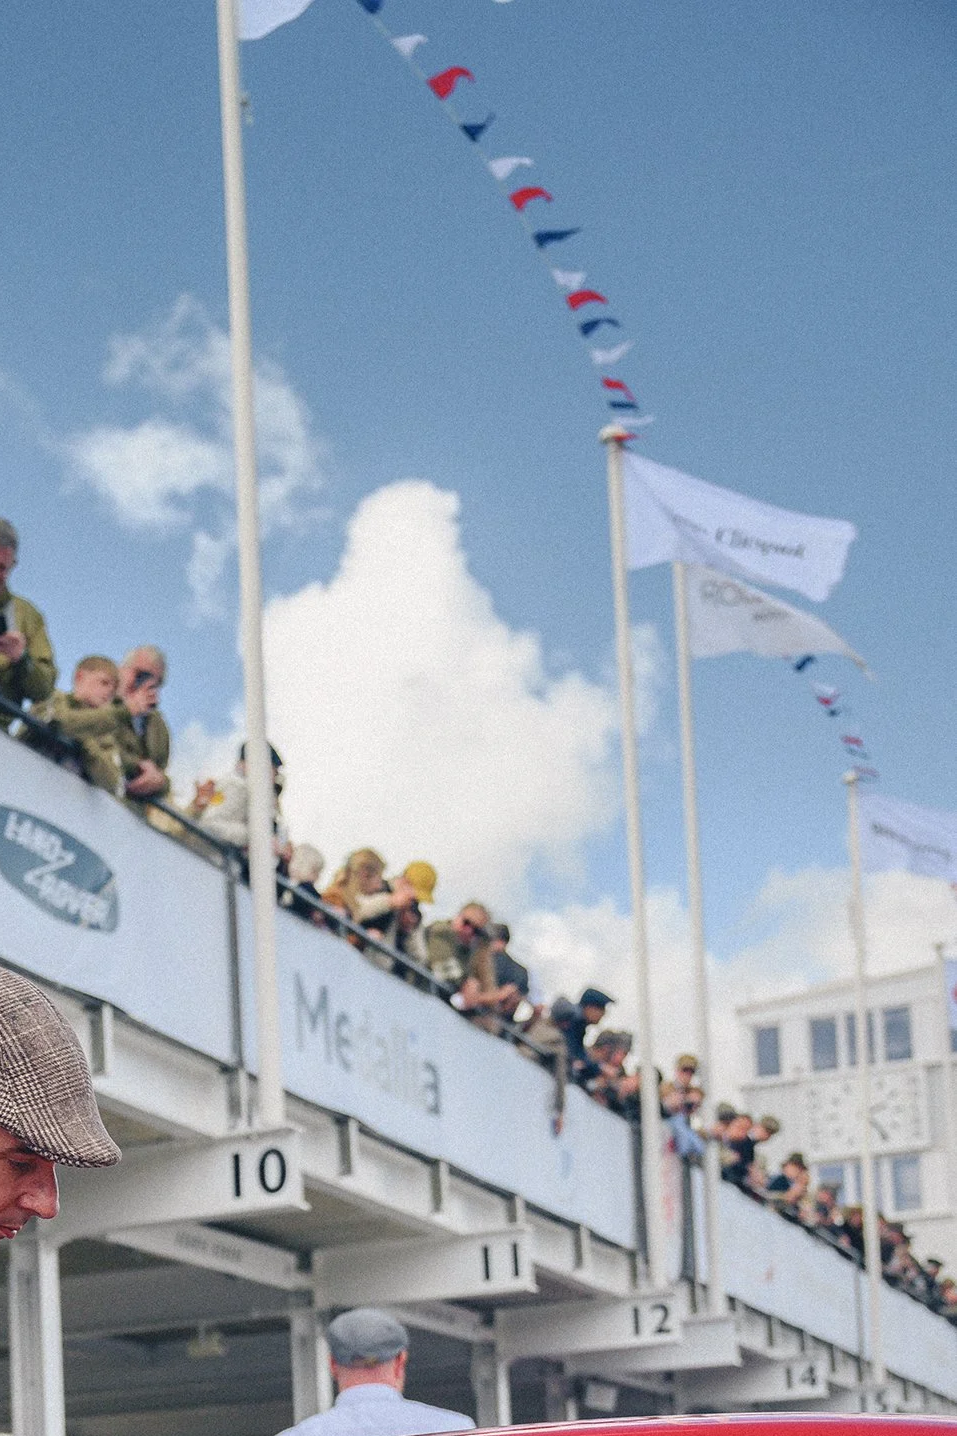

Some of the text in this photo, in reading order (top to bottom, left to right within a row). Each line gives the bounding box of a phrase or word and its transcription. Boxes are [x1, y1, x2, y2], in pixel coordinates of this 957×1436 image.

[233, 1149, 287, 1198] 10
[483, 1243, 520, 1282] 11
[634, 1304, 671, 1336] 12
[785, 1366, 817, 1390] 14
